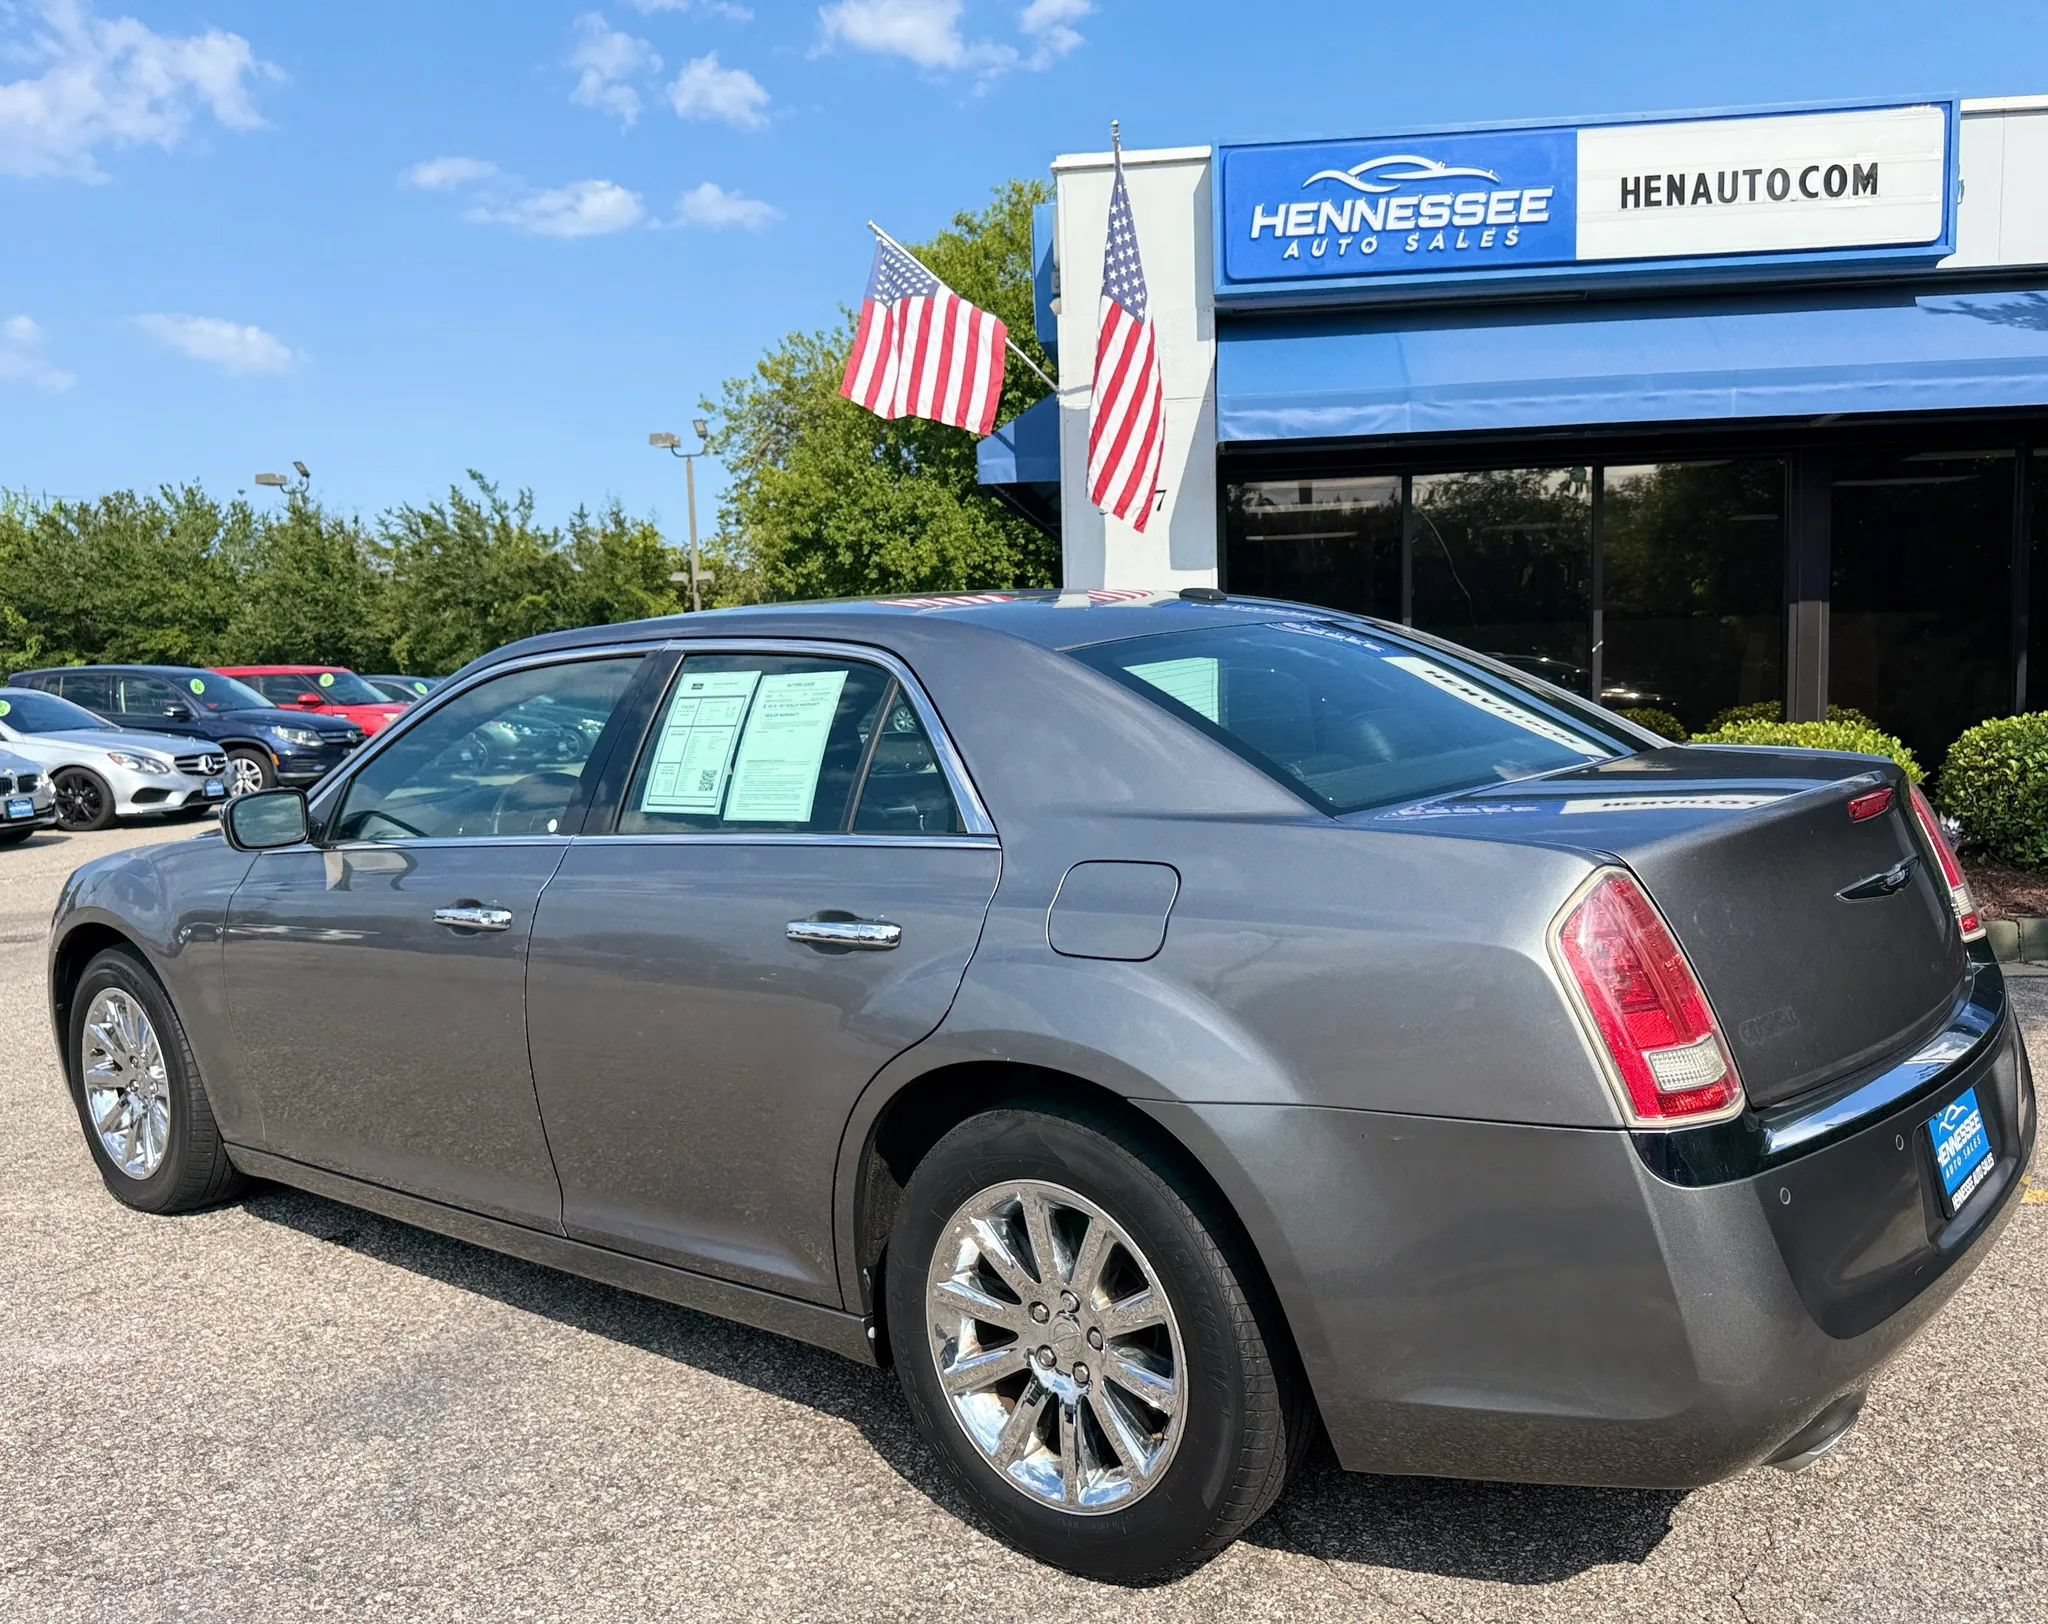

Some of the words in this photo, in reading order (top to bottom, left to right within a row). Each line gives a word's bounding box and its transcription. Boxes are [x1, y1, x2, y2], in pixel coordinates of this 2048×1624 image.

[1251, 186, 1554, 238] HENNESSEE
[1283, 235, 1378, 259] AUTO
[1405, 225, 1521, 252] SALES
[1937, 1109, 1982, 1168] HENNESSEE
[1945, 1156, 1962, 1180] AUTO
[1964, 1136, 1982, 1159] SALES
